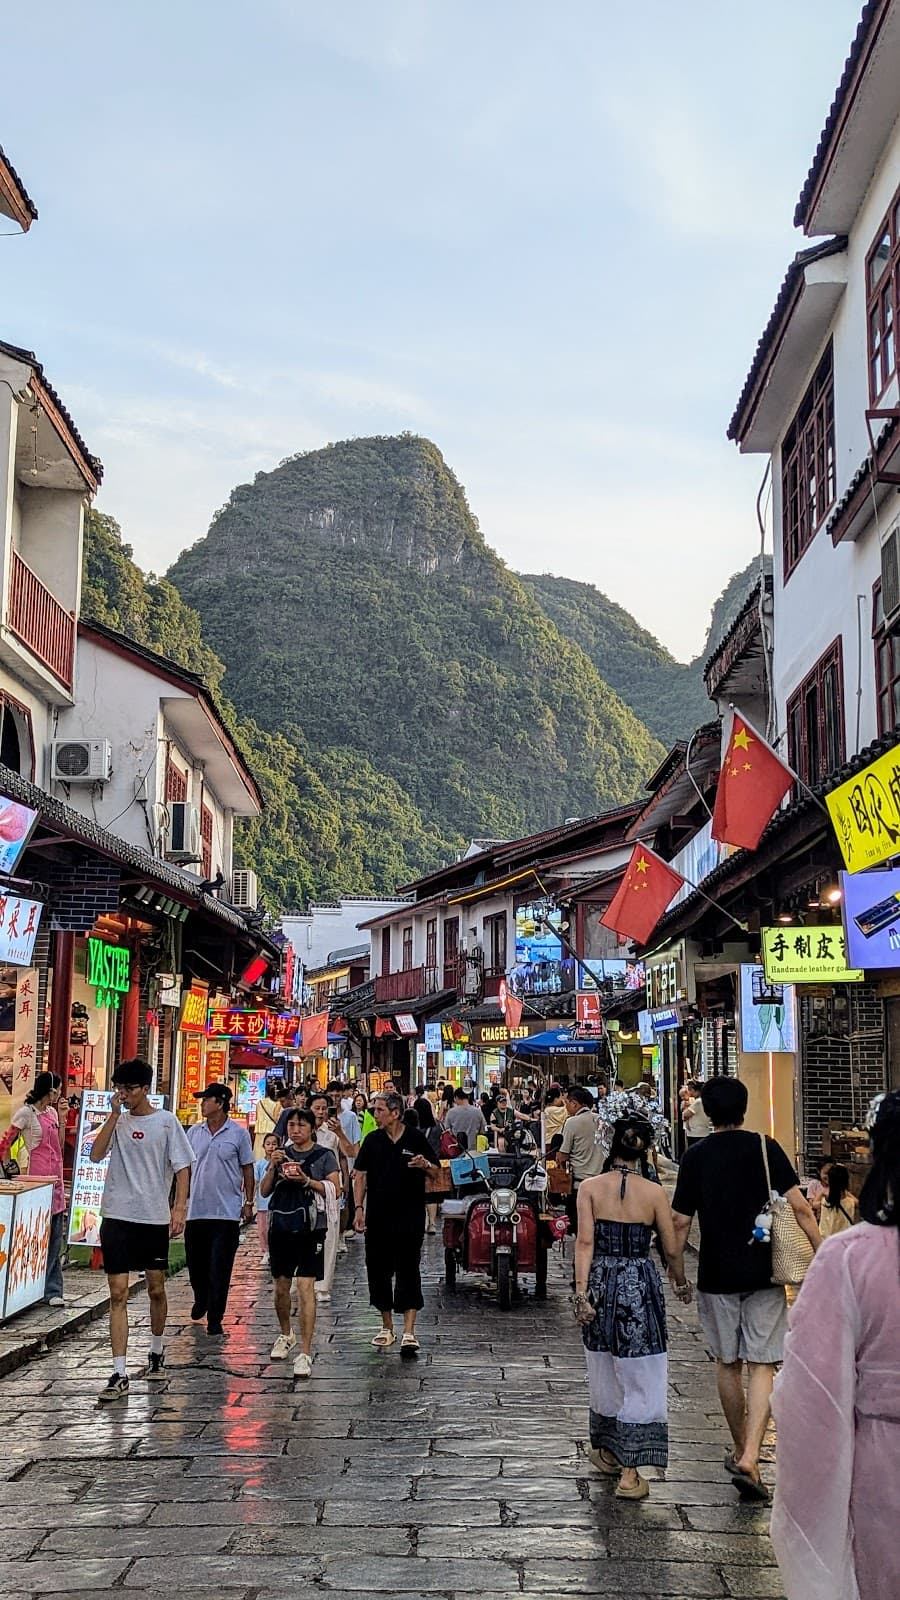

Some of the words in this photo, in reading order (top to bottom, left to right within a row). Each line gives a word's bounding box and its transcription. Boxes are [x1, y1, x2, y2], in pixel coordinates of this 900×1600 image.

[88, 937, 130, 992] YASTEE
[771, 965, 807, 973] Handmade
[809, 964, 834, 973] leather
[18, 979, 34, 1020] 采耳
[210, 1013, 265, 1034] 真朱砂
[481, 1026, 508, 1041] CHAGEE
[16, 1042, 34, 1082] 按摩
